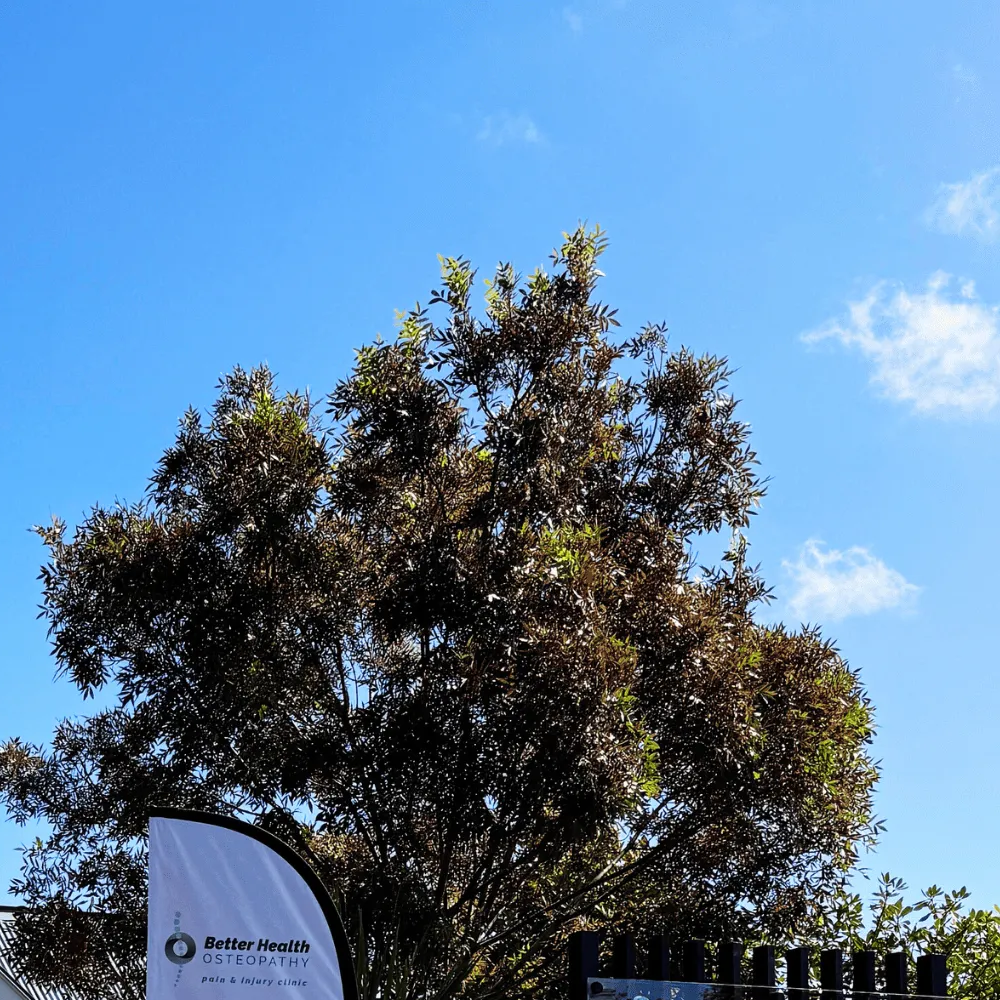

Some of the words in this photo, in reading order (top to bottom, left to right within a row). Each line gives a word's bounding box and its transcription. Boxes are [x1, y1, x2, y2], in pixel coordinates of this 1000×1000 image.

[204, 936, 254, 951] Better
[257, 938, 310, 953] Health
[203, 953, 309, 968] OSTEOPATHY
[202, 975, 225, 984] pain
[230, 976, 236, 984] &
[241, 976, 273, 987] injury
[278, 978, 308, 986] clinic
